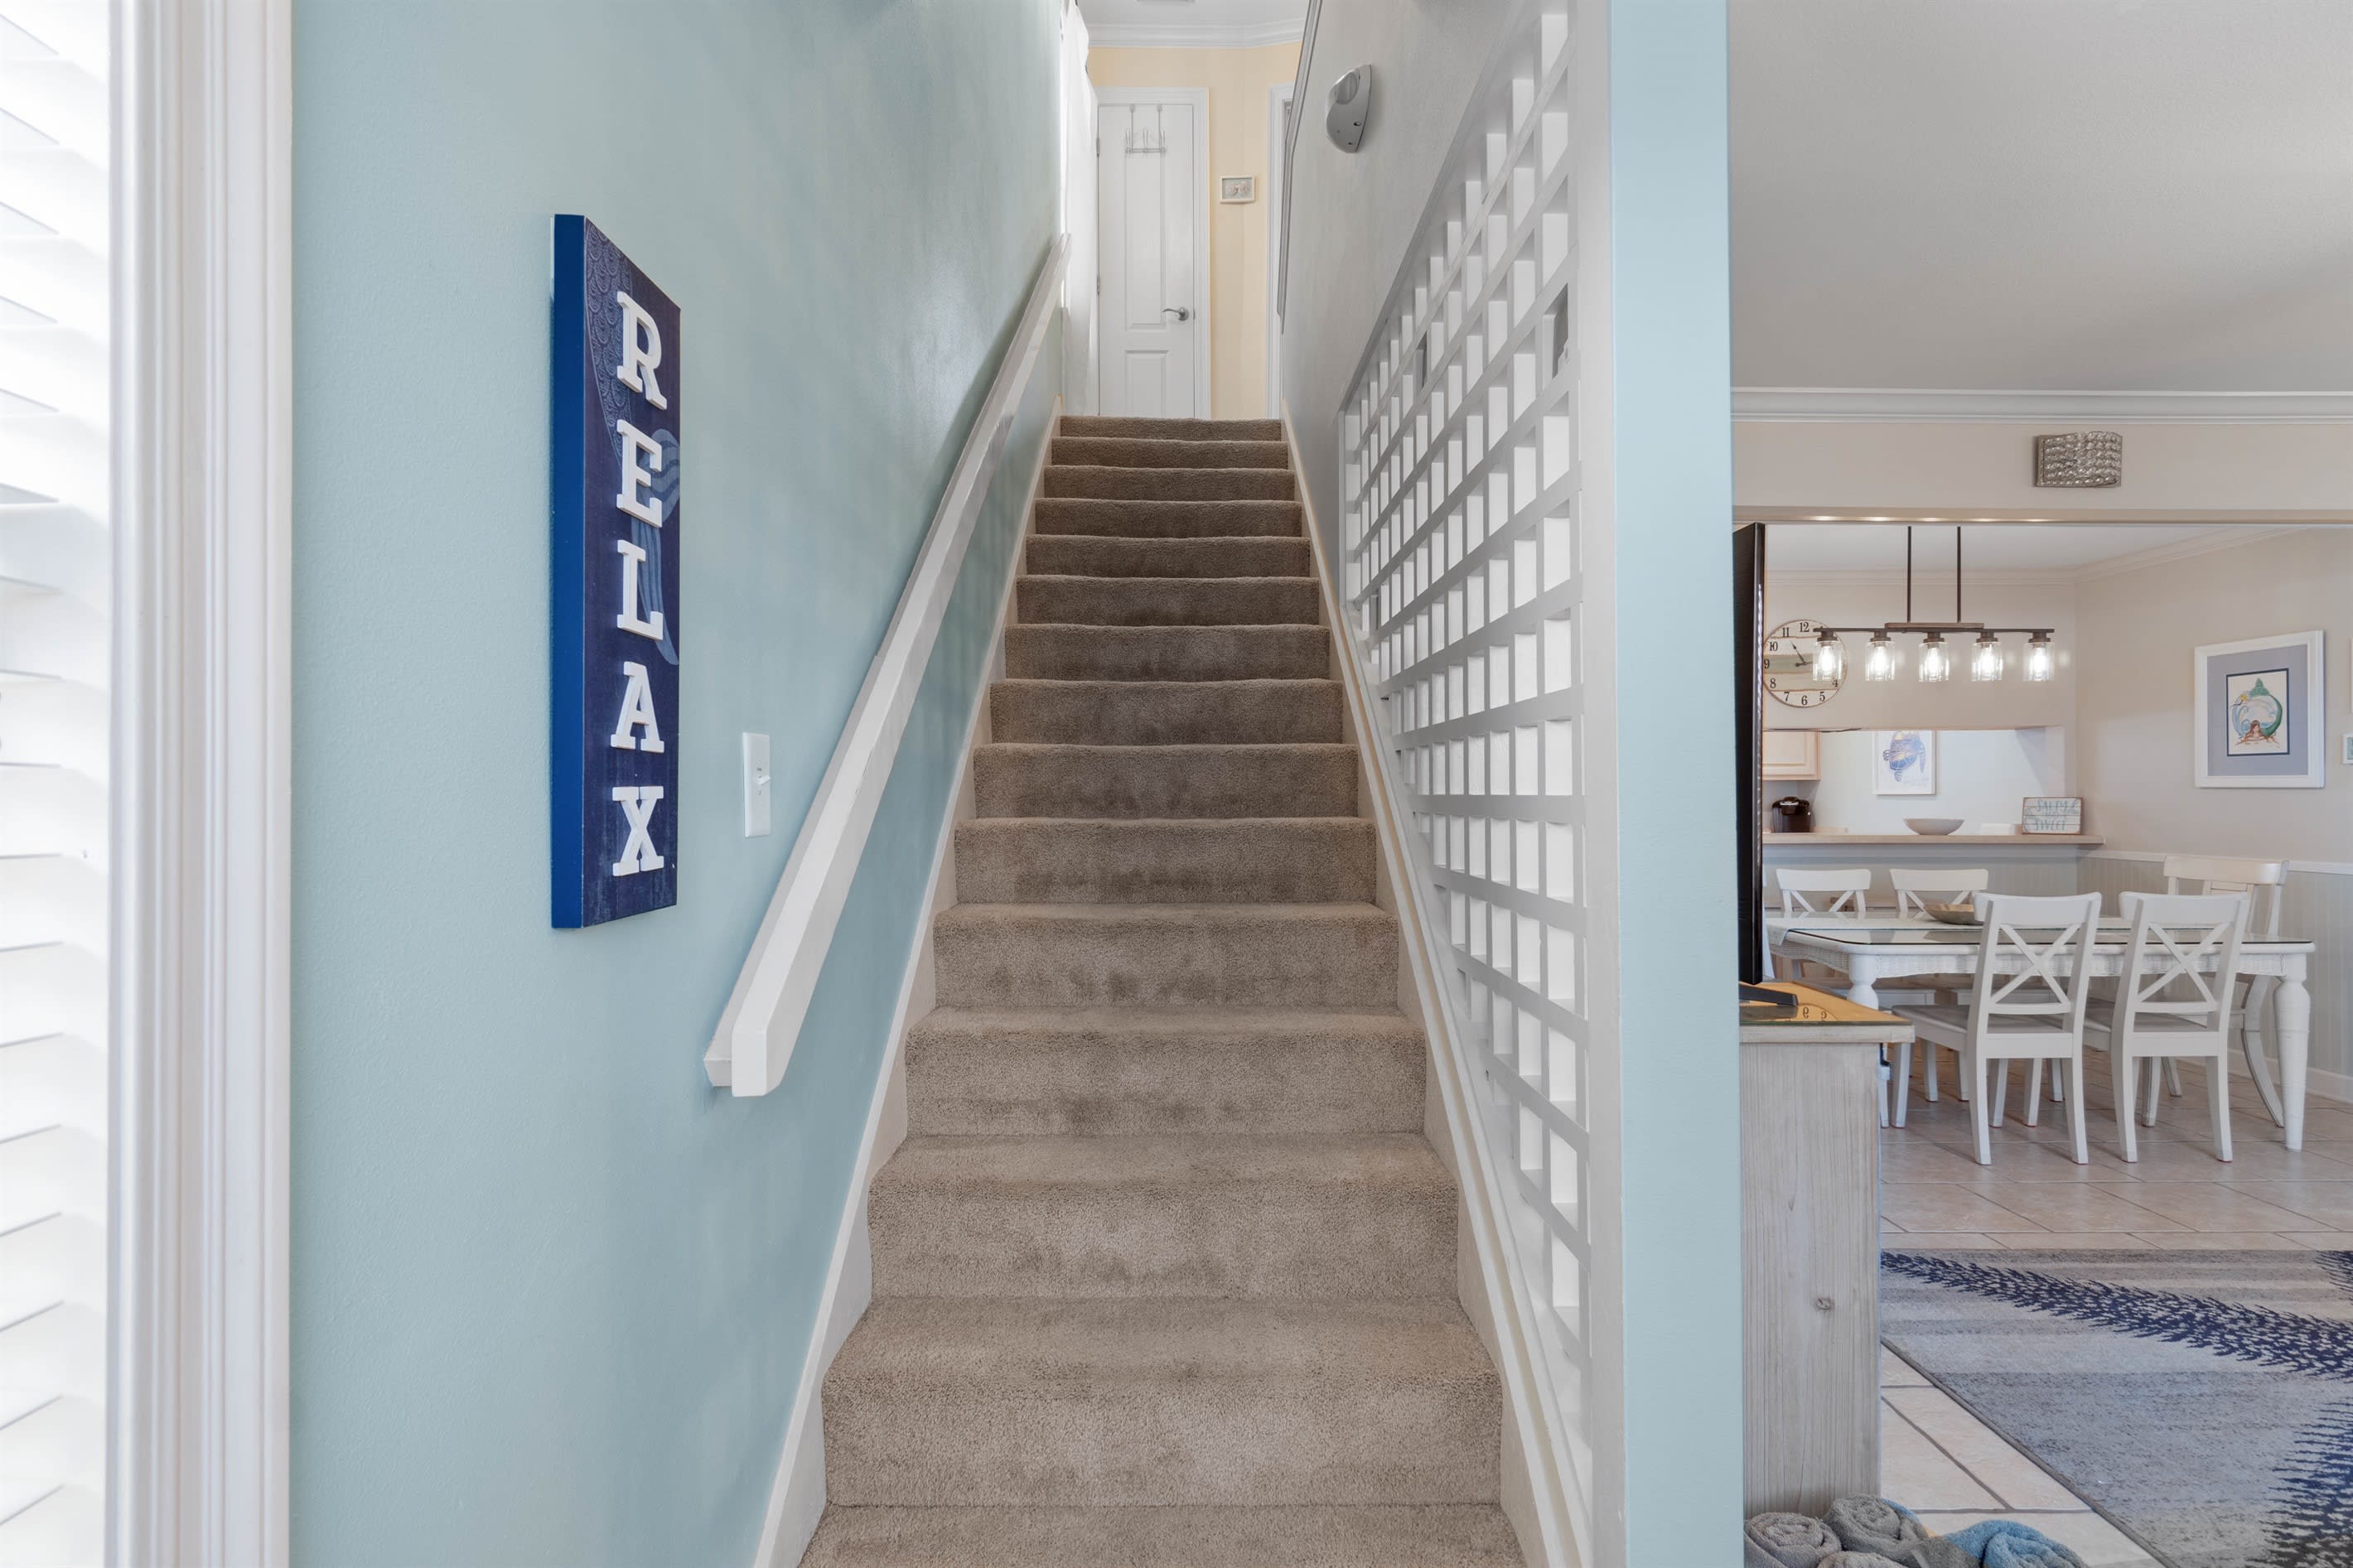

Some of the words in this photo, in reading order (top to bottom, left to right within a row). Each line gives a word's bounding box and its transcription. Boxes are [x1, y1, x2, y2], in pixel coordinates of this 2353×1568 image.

[611, 290, 667, 877] RELAX
[1782, 627, 1790, 638] 11
[1799, 621, 1809, 633] 12
[1769, 641, 1778, 652] 10
[1763, 659, 1770, 669] 9
[1770, 678, 1776, 688] 8
[1784, 692, 1790, 702] 7
[1801, 695, 1808, 706] 6
[1819, 692, 1825, 702] 5
